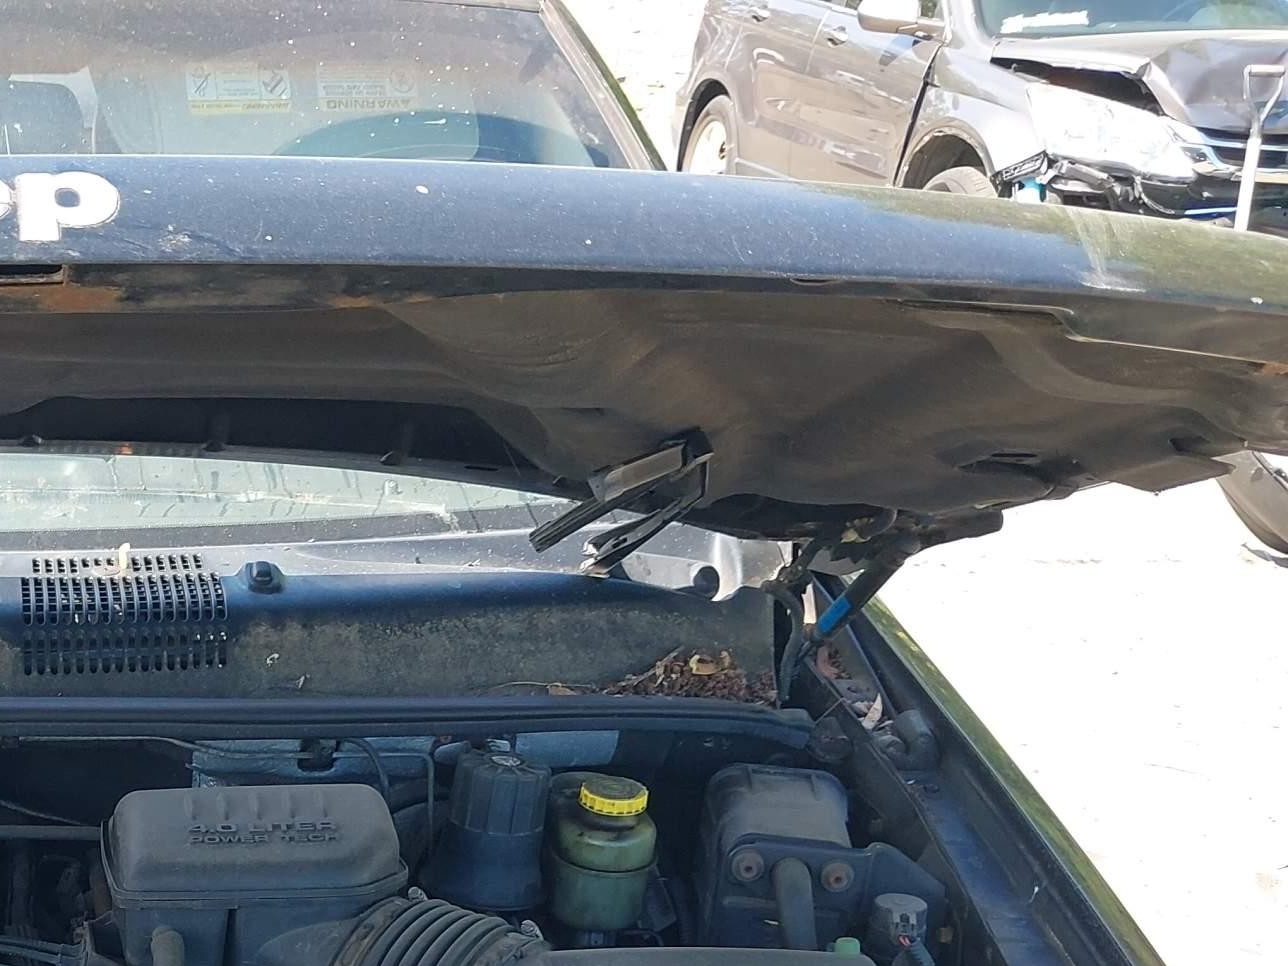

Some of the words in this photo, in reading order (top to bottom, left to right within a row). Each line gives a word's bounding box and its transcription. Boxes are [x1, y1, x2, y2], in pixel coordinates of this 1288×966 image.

[326, 99, 400, 110] WARNING
[188, 822, 237, 834] 4.0
[249, 819, 338, 833] LITER
[187, 834, 270, 844] POWER
[280, 832, 343, 843] TECH
